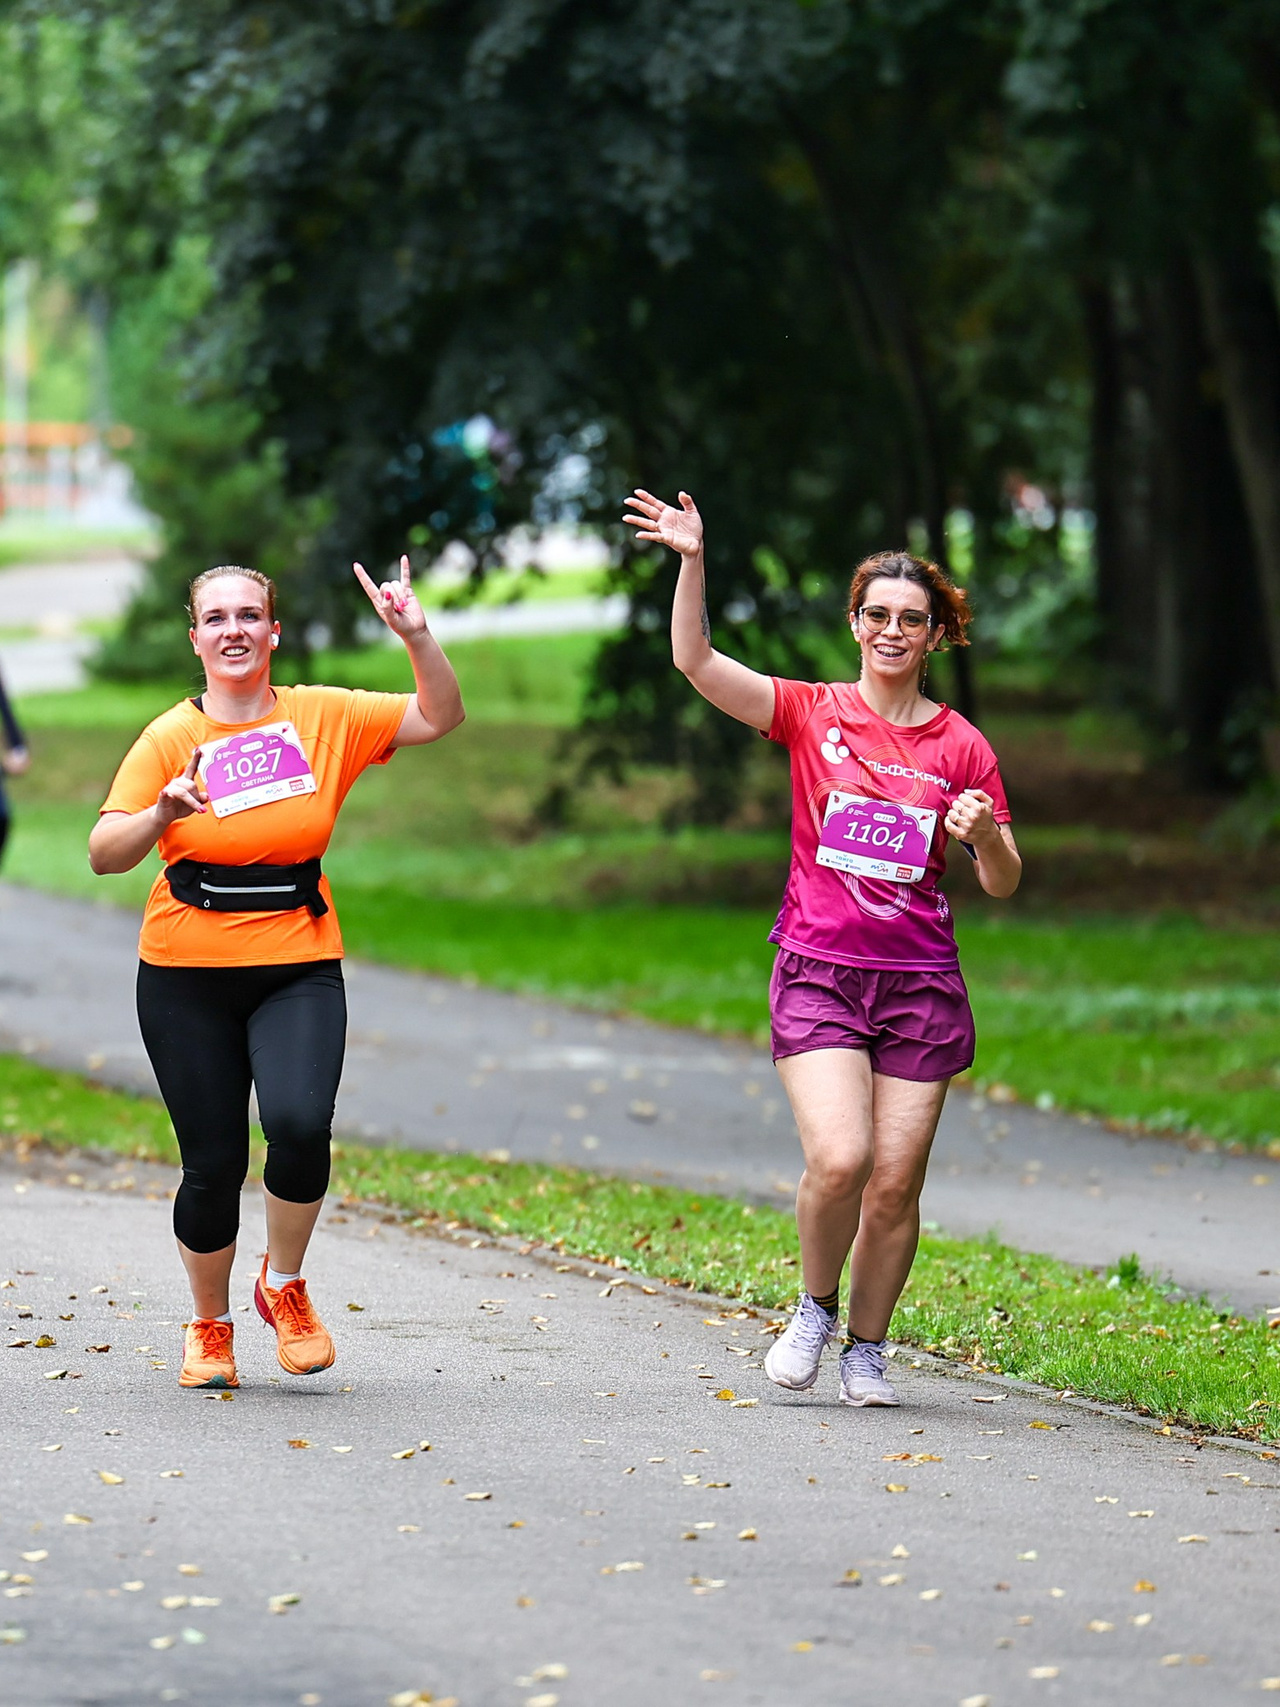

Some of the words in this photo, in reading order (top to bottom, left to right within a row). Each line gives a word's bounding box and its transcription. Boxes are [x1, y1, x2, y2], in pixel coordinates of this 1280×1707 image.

[223, 747, 283, 783] 1027
[241, 774, 274, 788] СВЕТЛАНА
[843, 821, 907, 853] 1104
